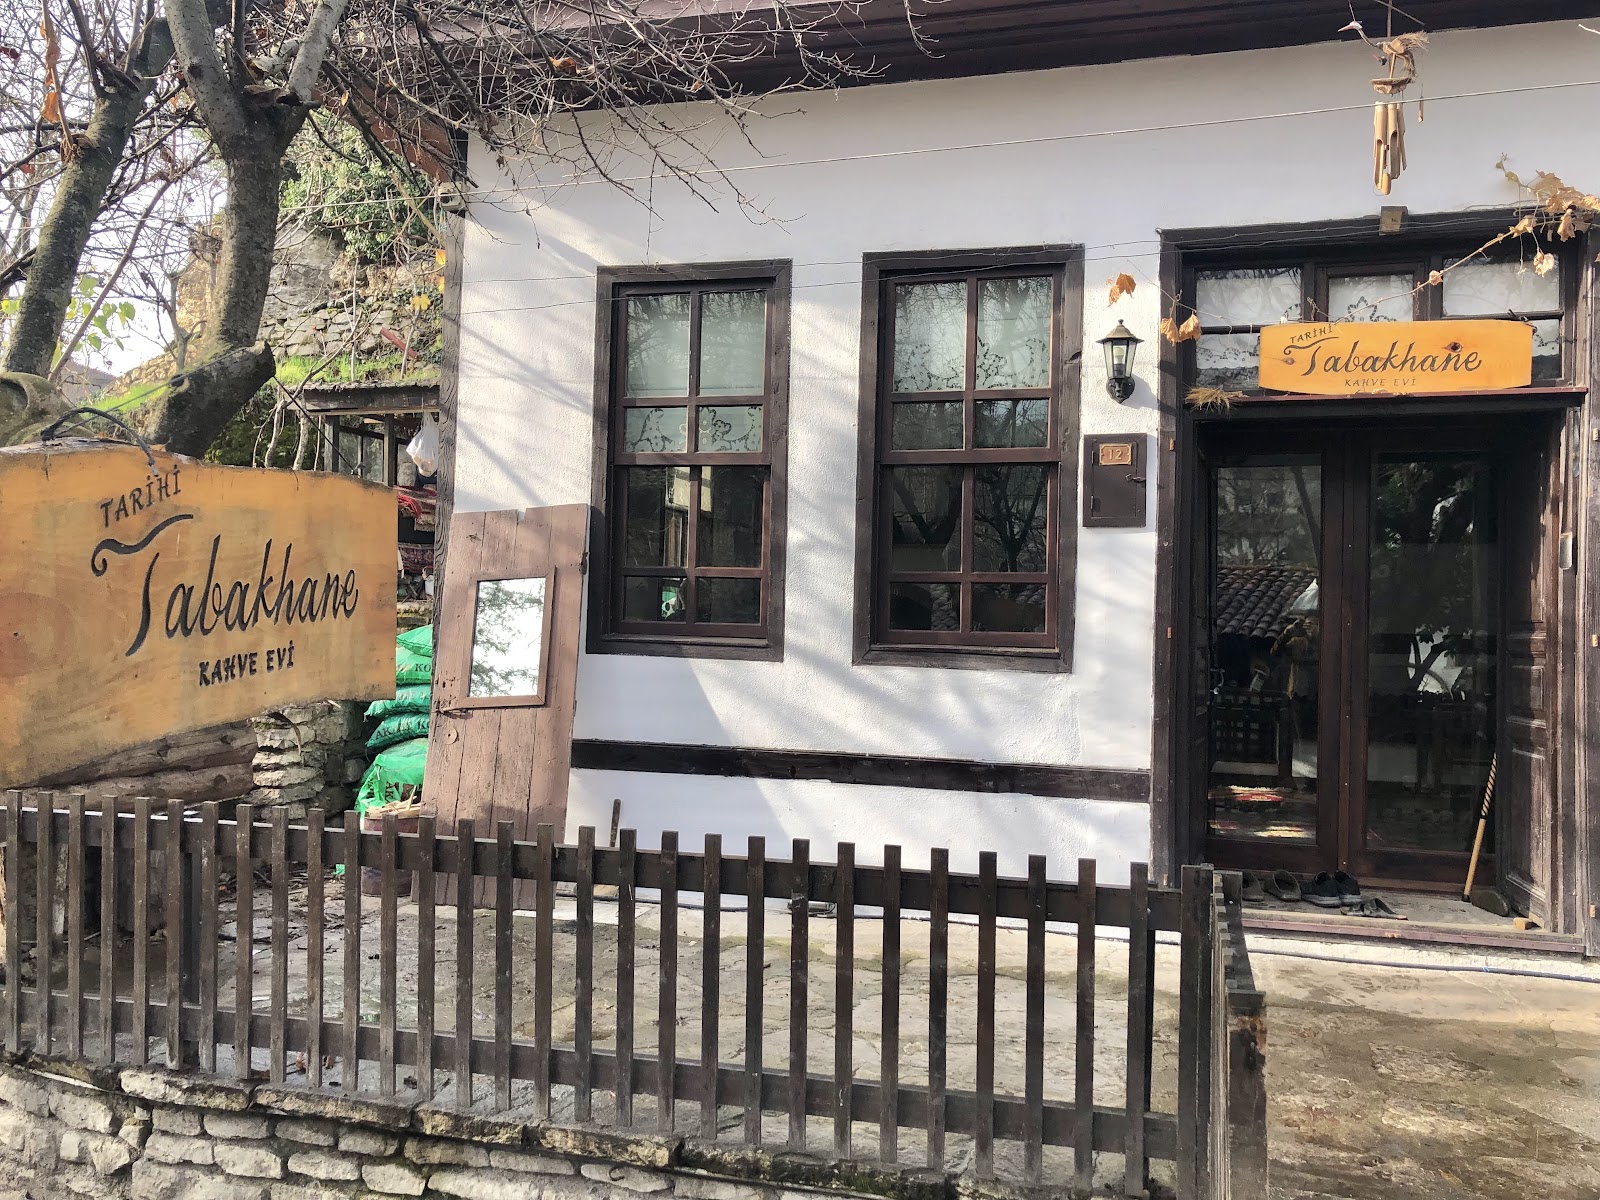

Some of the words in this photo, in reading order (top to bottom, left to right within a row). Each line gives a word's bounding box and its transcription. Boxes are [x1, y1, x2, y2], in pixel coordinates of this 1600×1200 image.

[1289, 323, 1334, 344] TARİHİ
[1283, 336, 1483, 377] Tabakhane
[1344, 378, 1386, 388] KAHVE
[1393, 376, 1417, 387] EVİ
[1107, 448, 1123, 461] 12
[100, 463, 182, 528] TARİHİ
[91, 513, 359, 657] Tabakhane
[199, 651, 258, 687] KAHVE
[266, 639, 295, 673] EVİ
